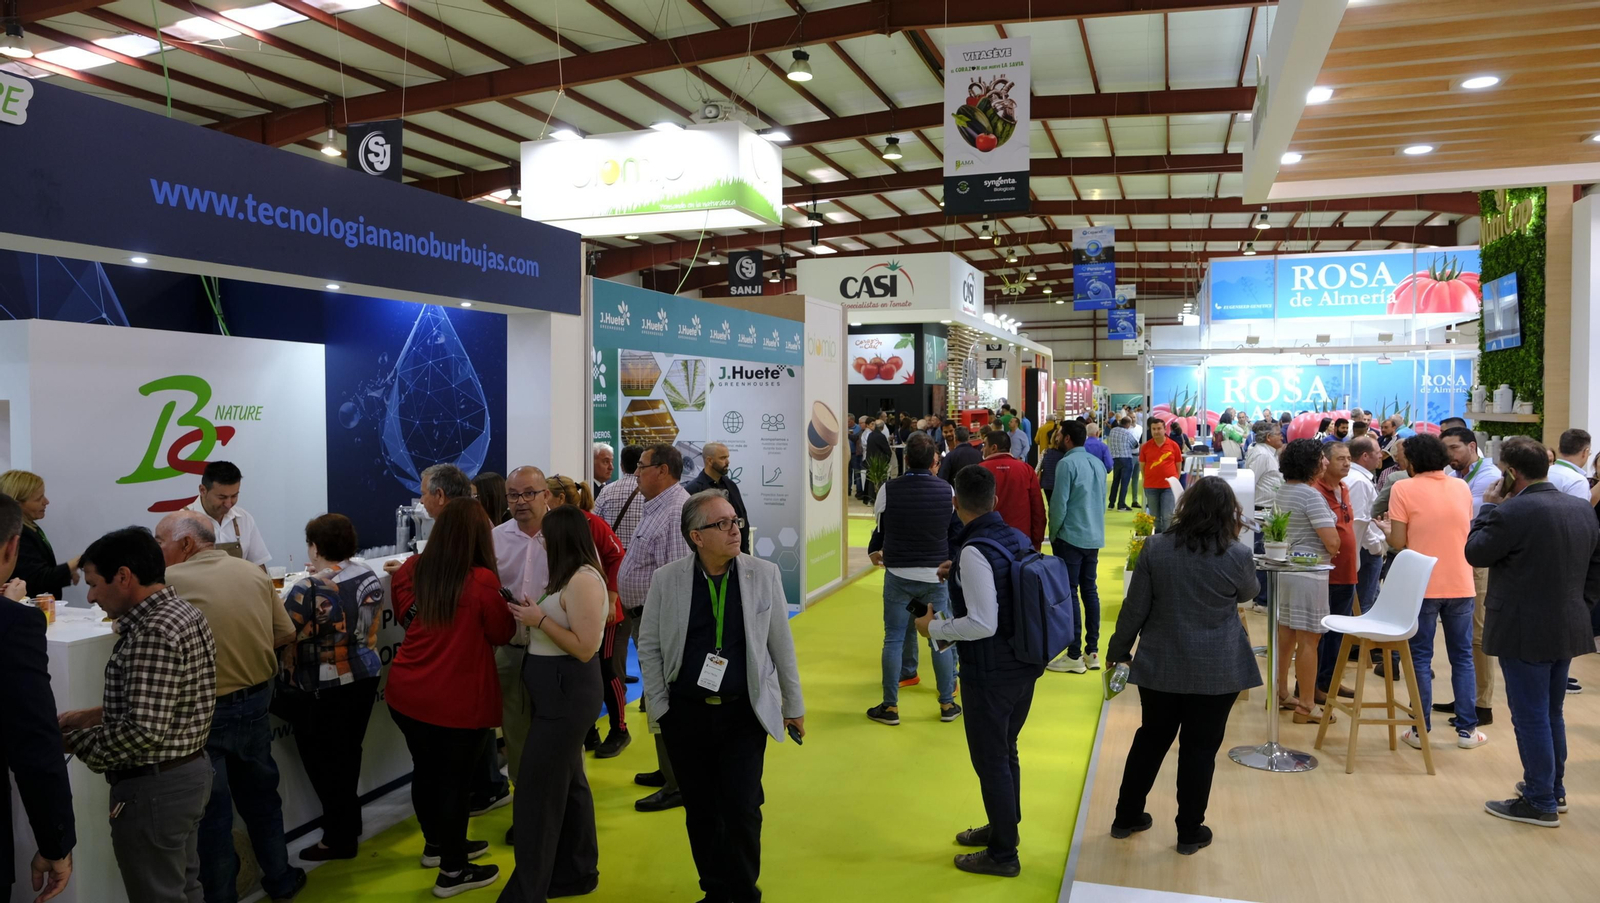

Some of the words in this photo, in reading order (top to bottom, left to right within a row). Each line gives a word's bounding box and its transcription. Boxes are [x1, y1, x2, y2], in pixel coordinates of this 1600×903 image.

[963, 47, 1012, 61] VITASÈVE
[984, 177, 1016, 187] syngenta
[149, 178, 540, 278] www.tecnologiananoburbujas.com
[1291, 261, 1397, 291] ROSA
[730, 285, 762, 295] SANJI
[839, 274, 897, 299] CASI
[889, 300, 912, 308] Tomate
[1289, 291, 1313, 307] de
[1317, 289, 1397, 306] Almería
[600, 312, 625, 326] J.Huete
[641, 319, 664, 331] J.Huete
[678, 324, 697, 336] J.Huete
[718, 366, 780, 379] J.Huete
[1421, 375, 1467, 386] ROSA
[1222, 375, 1331, 403] ROSA
[214, 405, 264, 421] NATURE
